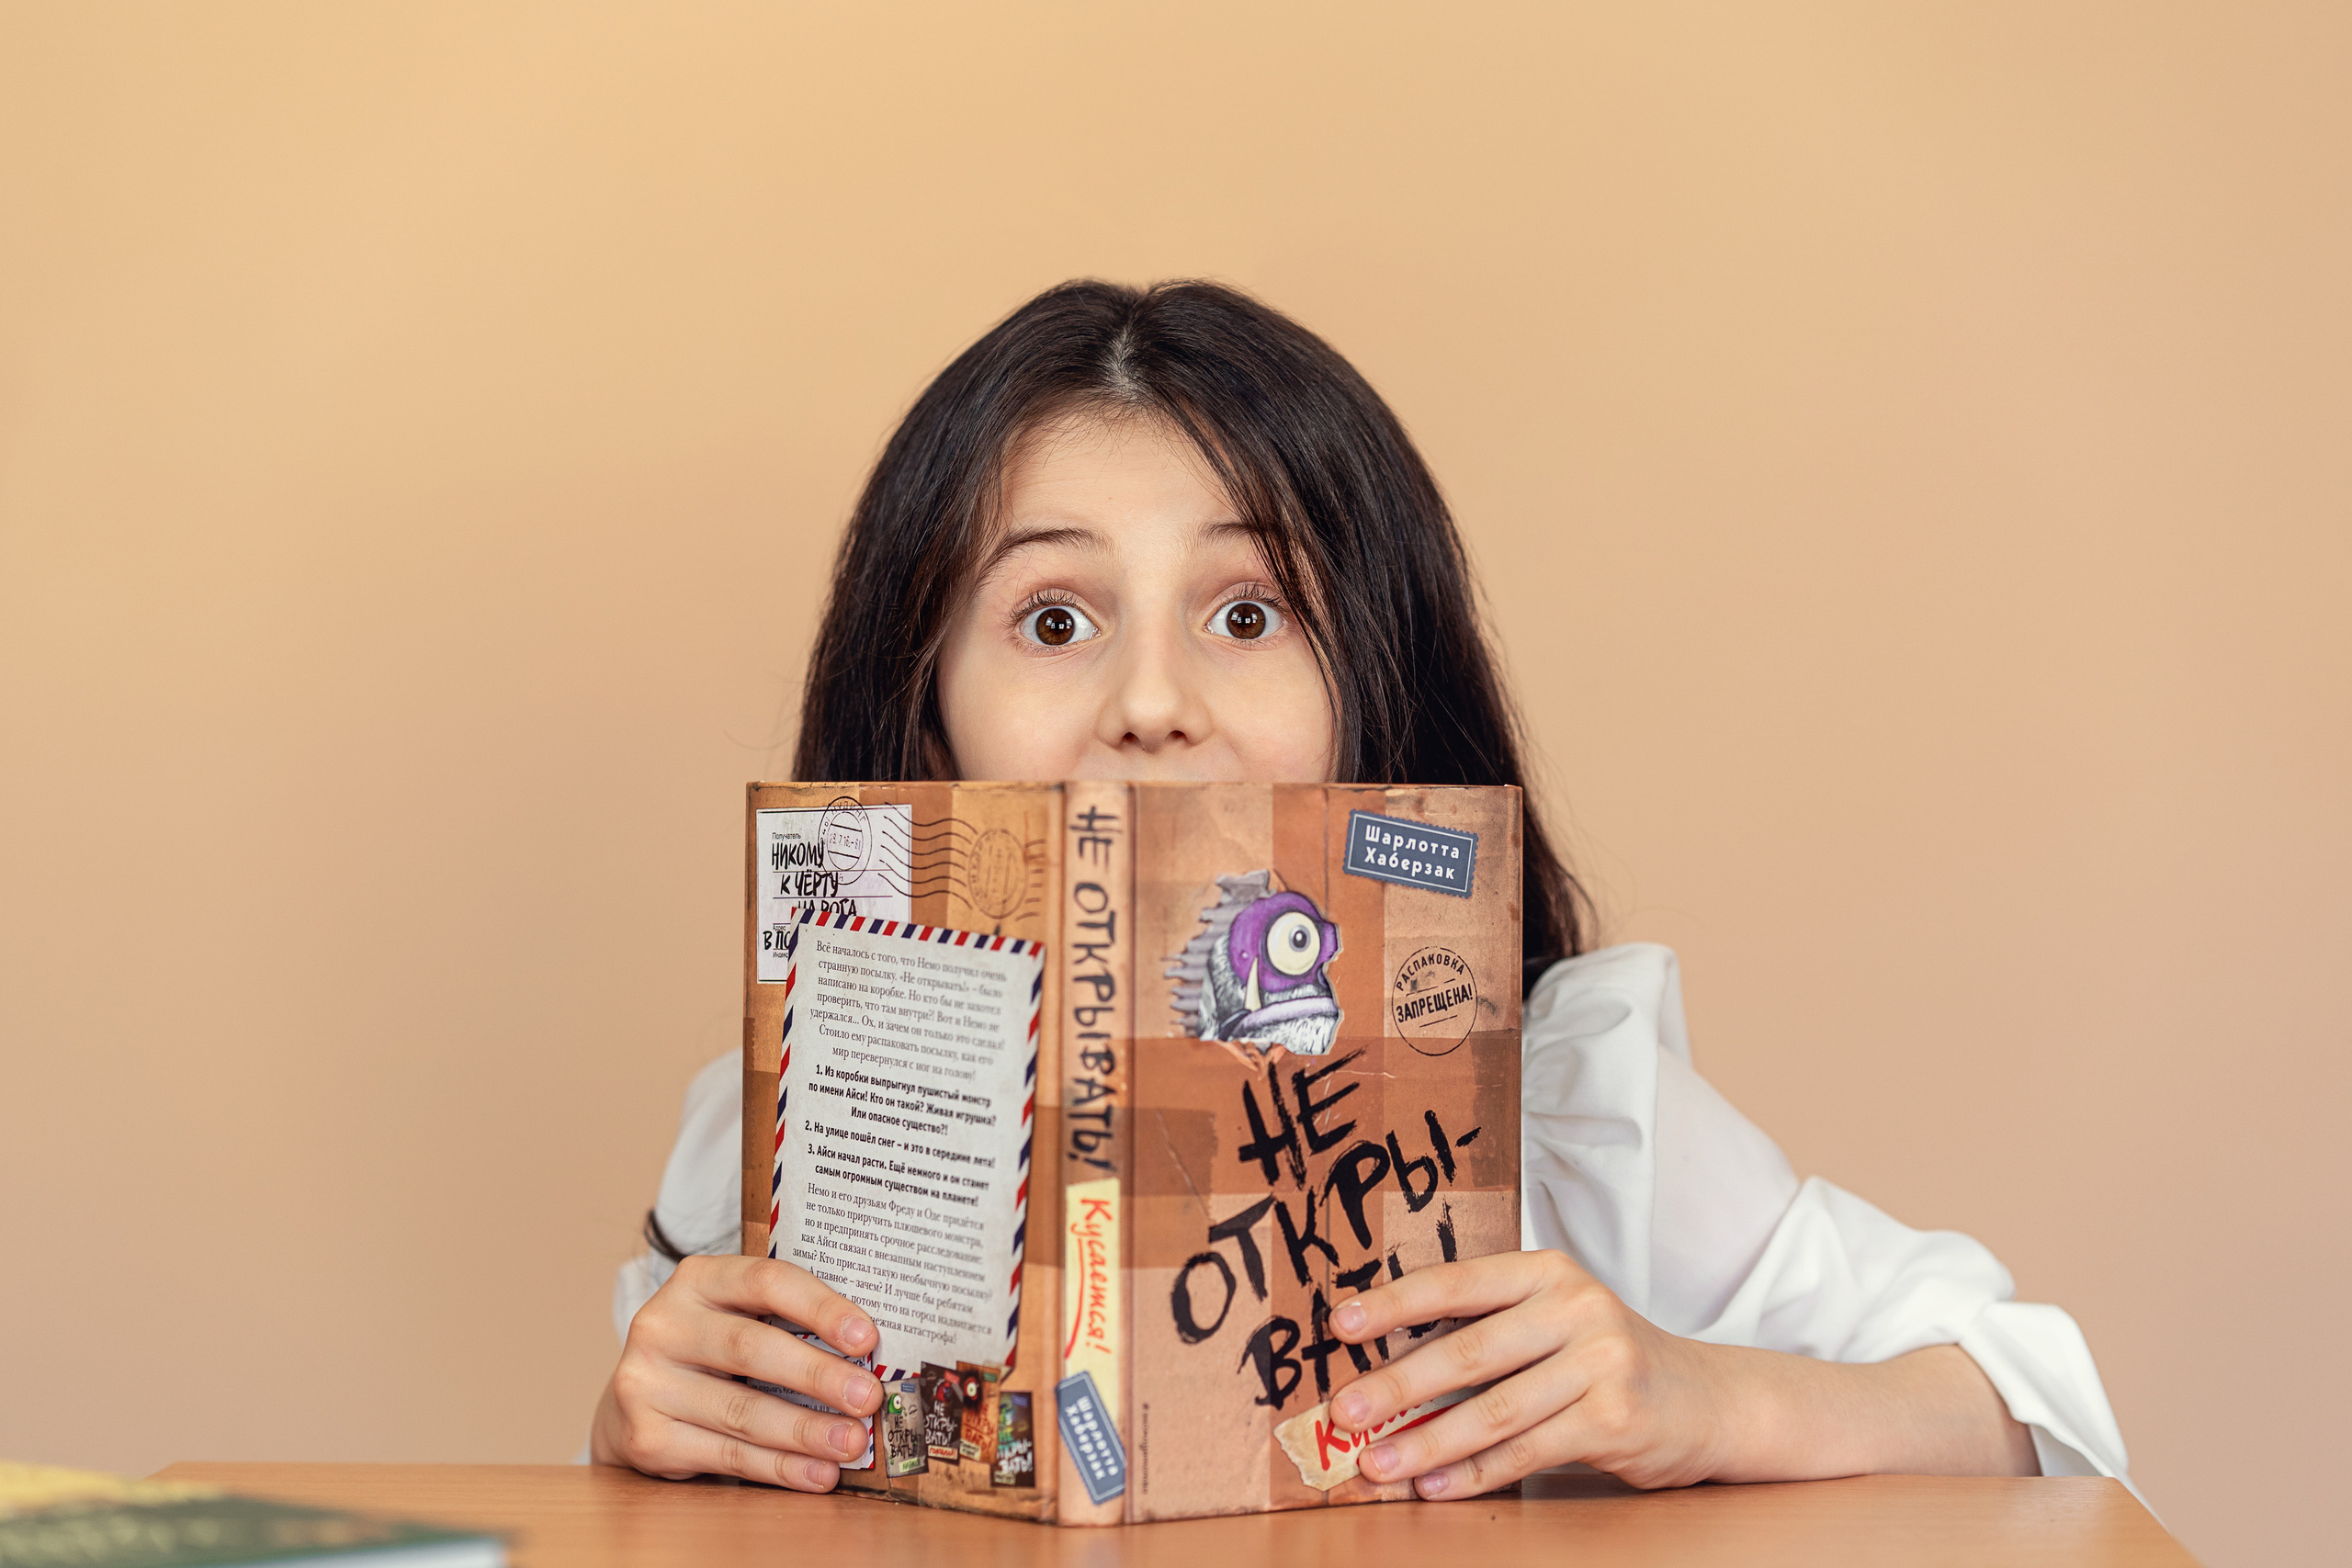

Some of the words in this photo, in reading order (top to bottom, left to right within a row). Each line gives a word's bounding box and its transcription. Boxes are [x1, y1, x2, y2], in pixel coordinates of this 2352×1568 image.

[772, 842, 825, 870] НИКОМУ
[1069, 805, 1124, 874] НЕ
[1365, 824, 1460, 859] Шарлотта
[1364, 846, 1456, 880] Хаберзак
[795, 868, 839, 897] ЧЁРТУ
[763, 931, 773, 951] В
[816, 940, 831, 953] Всё
[831, 945, 870, 960] началось
[870, 952, 876, 961] с
[876, 953, 899, 965] того,
[899, 956, 916, 967] что
[917, 956, 942, 972] Немо
[818, 960, 859, 976] странную
[860, 967, 898, 984] посылку.
[899, 971, 916, 985] «Не
[1396, 953, 1465, 992] РАСПАКОВКА
[817, 993, 863, 1010] проверить,
[865, 1001, 880, 1011] что
[880, 1004, 897, 1015] там
[898, 1007, 935, 1023] внутри?!
[818, 976, 857, 991] написано
[858, 983, 869, 993] на
[870, 986, 907, 999] коробке.
[908, 988, 922, 1002] Но
[922, 995, 939, 1005] кто
[1396, 983, 1474, 1024] ЗАПРЕЩЕНА!
[809, 1008, 860, 1025] удержался...
[861, 1014, 876, 1028] Ох,
[877, 1021, 885, 1030] и
[885, 1021, 910, 1034] зачем
[910, 1026, 922, 1037] он
[923, 1028, 955, 1042] только
[819, 1023, 850, 1040] Стоило
[851, 1032, 866, 1046] ему
[866, 1035, 920, 1053] распаковать
[1067, 881, 1118, 1173] ОТКРЫВАТЬ!
[831, 1046, 850, 1061] мир
[850, 1050, 908, 1069] перевернулся
[909, 1061, 914, 1070] с
[915, 1062, 931, 1073] ног
[816, 1064, 823, 1076] 1.
[824, 1065, 835, 1077] Из
[835, 1069, 869, 1084] коробки
[870, 1077, 916, 1095] выпрыгнул
[917, 1085, 960, 1100] пушистый
[808, 1082, 819, 1092] по
[820, 1084, 844, 1098] имени
[845, 1087, 868, 1102] Айси!
[869, 1091, 884, 1105] Кто
[885, 1097, 896, 1107] он
[897, 1100, 925, 1113] такой?
[925, 1102, 954, 1118] Живая
[1238, 1045, 1367, 1190] НЕ
[851, 1106, 867, 1120] Или
[868, 1111, 900, 1126] опасное
[901, 1119, 948, 1135] существо?!
[805, 1120, 812, 1132] 2.
[814, 1121, 824, 1134] На
[824, 1126, 849, 1140] улице
[850, 1131, 876, 1145] пошёл
[877, 1137, 896, 1148] снег
[903, 1142, 910, 1151] и
[910, 1144, 924, 1155] это
[925, 1146, 931, 1156] в
[932, 1148, 971, 1164] середине
[808, 1143, 815, 1156] 3.
[816, 1145, 836, 1159] Айси
[837, 1151, 861, 1165] начал
[862, 1156, 888, 1170] расти.
[888, 1159, 906, 1175] Ещё
[907, 1166, 942, 1181] немного
[949, 1175, 960, 1184] он
[961, 1178, 989, 1190] станет
[815, 1165, 841, 1179] самым
[842, 1170, 883, 1187] огромным
[884, 1179, 929, 1196] существом
[930, 1190, 940, 1200] на
[808, 1182, 831, 1198] Немо
[831, 1190, 837, 1200] и
[838, 1191, 853, 1202] его
[853, 1195, 887, 1210] друзьям
[888, 1200, 915, 1216] Фреду
[916, 1209, 923, 1218] и
[923, 1207, 942, 1222] Оде
[805, 1217, 816, 1227] но
[816, 1220, 822, 1229] и
[823, 1222, 879, 1242] предпринять
[879, 1235, 916, 1250] срочное
[806, 1201, 817, 1212] не
[817, 1203, 846, 1218] только
[847, 1211, 893, 1228] приручить
[893, 1221, 944, 1239] плюшевого
[1170, 1110, 1482, 1345] ОТКРЫ-
[801, 1233, 816, 1245] как
[816, 1234, 838, 1249] Айси
[839, 1242, 867, 1256] связан
[867, 1248, 874, 1258] с
[874, 1250, 922, 1269] внезапным
[792, 1247, 818, 1261] зимы?
[819, 1251, 835, 1265] Кто
[836, 1258, 871, 1274] прислал
[872, 1266, 899, 1281] такую
[899, 1272, 951, 1292] необычную
[1070, 1199, 1113, 1354] Кусается!
[816, 1269, 848, 1285] главное
[855, 1279, 883, 1292] зачем?
[884, 1282, 893, 1295] И
[893, 1288, 922, 1303] лучше
[922, 1292, 935, 1305] бы
[935, 1297, 974, 1314] ребятам
[851, 1294, 882, 1311] потому
[882, 1303, 899, 1314] что
[899, 1306, 910, 1316] на
[910, 1309, 936, 1324] город
[903, 1324, 957, 1347] катастрофа!
[894, 1416, 904, 1429] НЕ
[933, 1400, 945, 1416] НЕ
[1065, 1404, 1106, 1480] Хаберзак
[1077, 1395, 1119, 1477] Шарлотта
